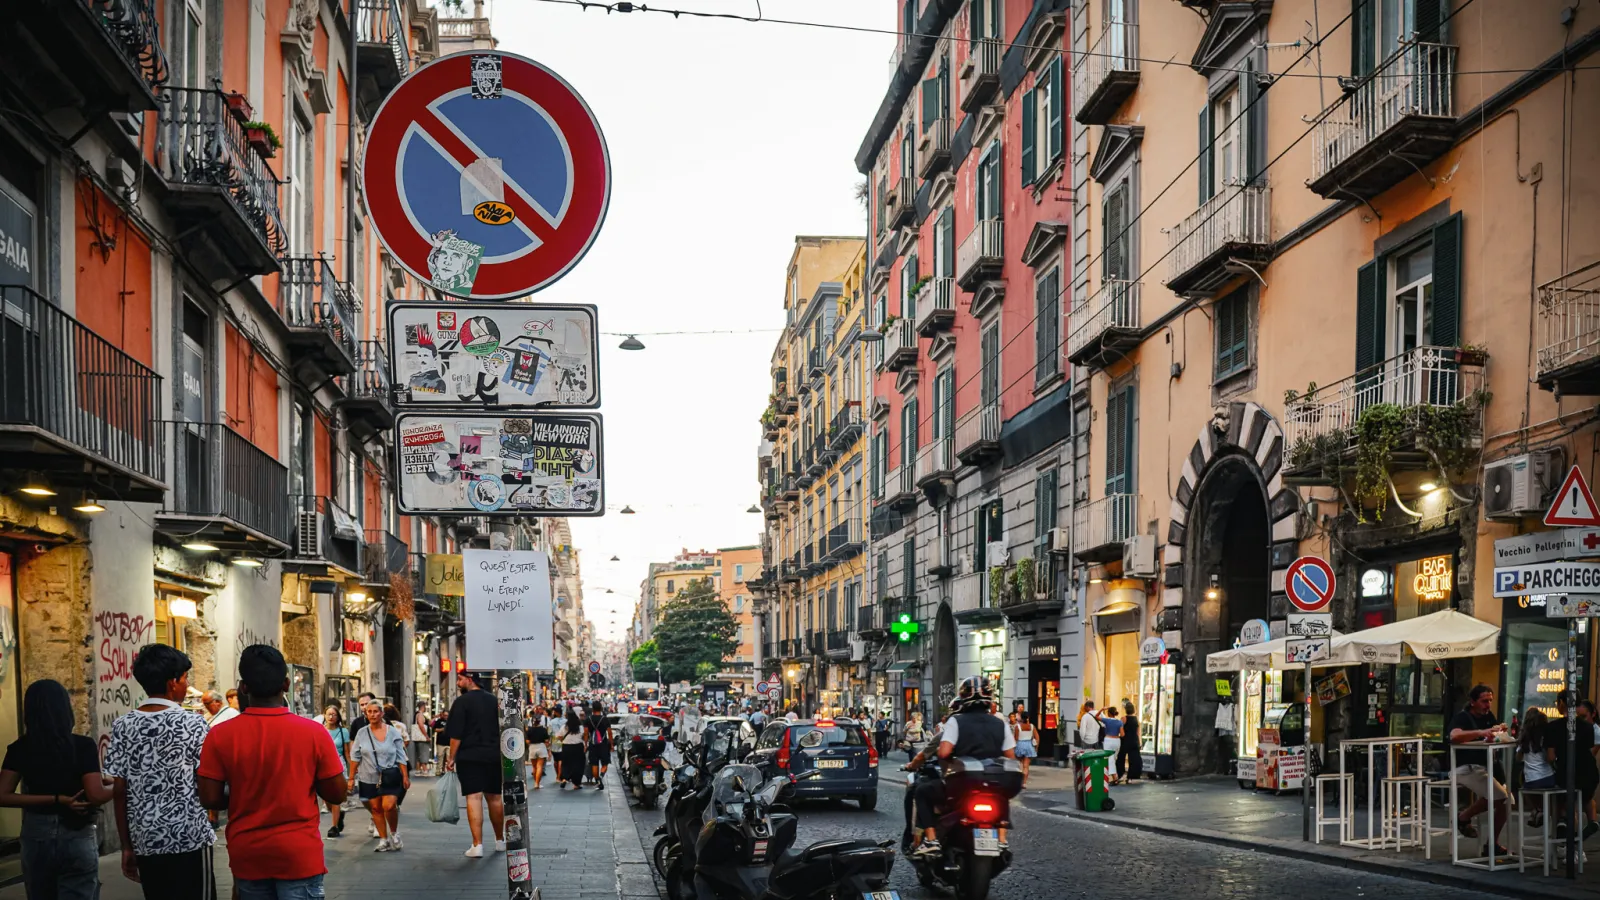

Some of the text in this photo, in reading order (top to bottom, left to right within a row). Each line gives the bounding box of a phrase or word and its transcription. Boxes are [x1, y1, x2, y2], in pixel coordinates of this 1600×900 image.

[183, 371, 200, 398] GAIA
[534, 422, 590, 436] VILLAINOUS
[406, 464, 434, 473] СВЕГА
[1498, 539, 1575, 557] Vecchio Pellegrini
[1423, 558, 1446, 575] BAR
[482, 585, 529, 595] UN ETERNO
